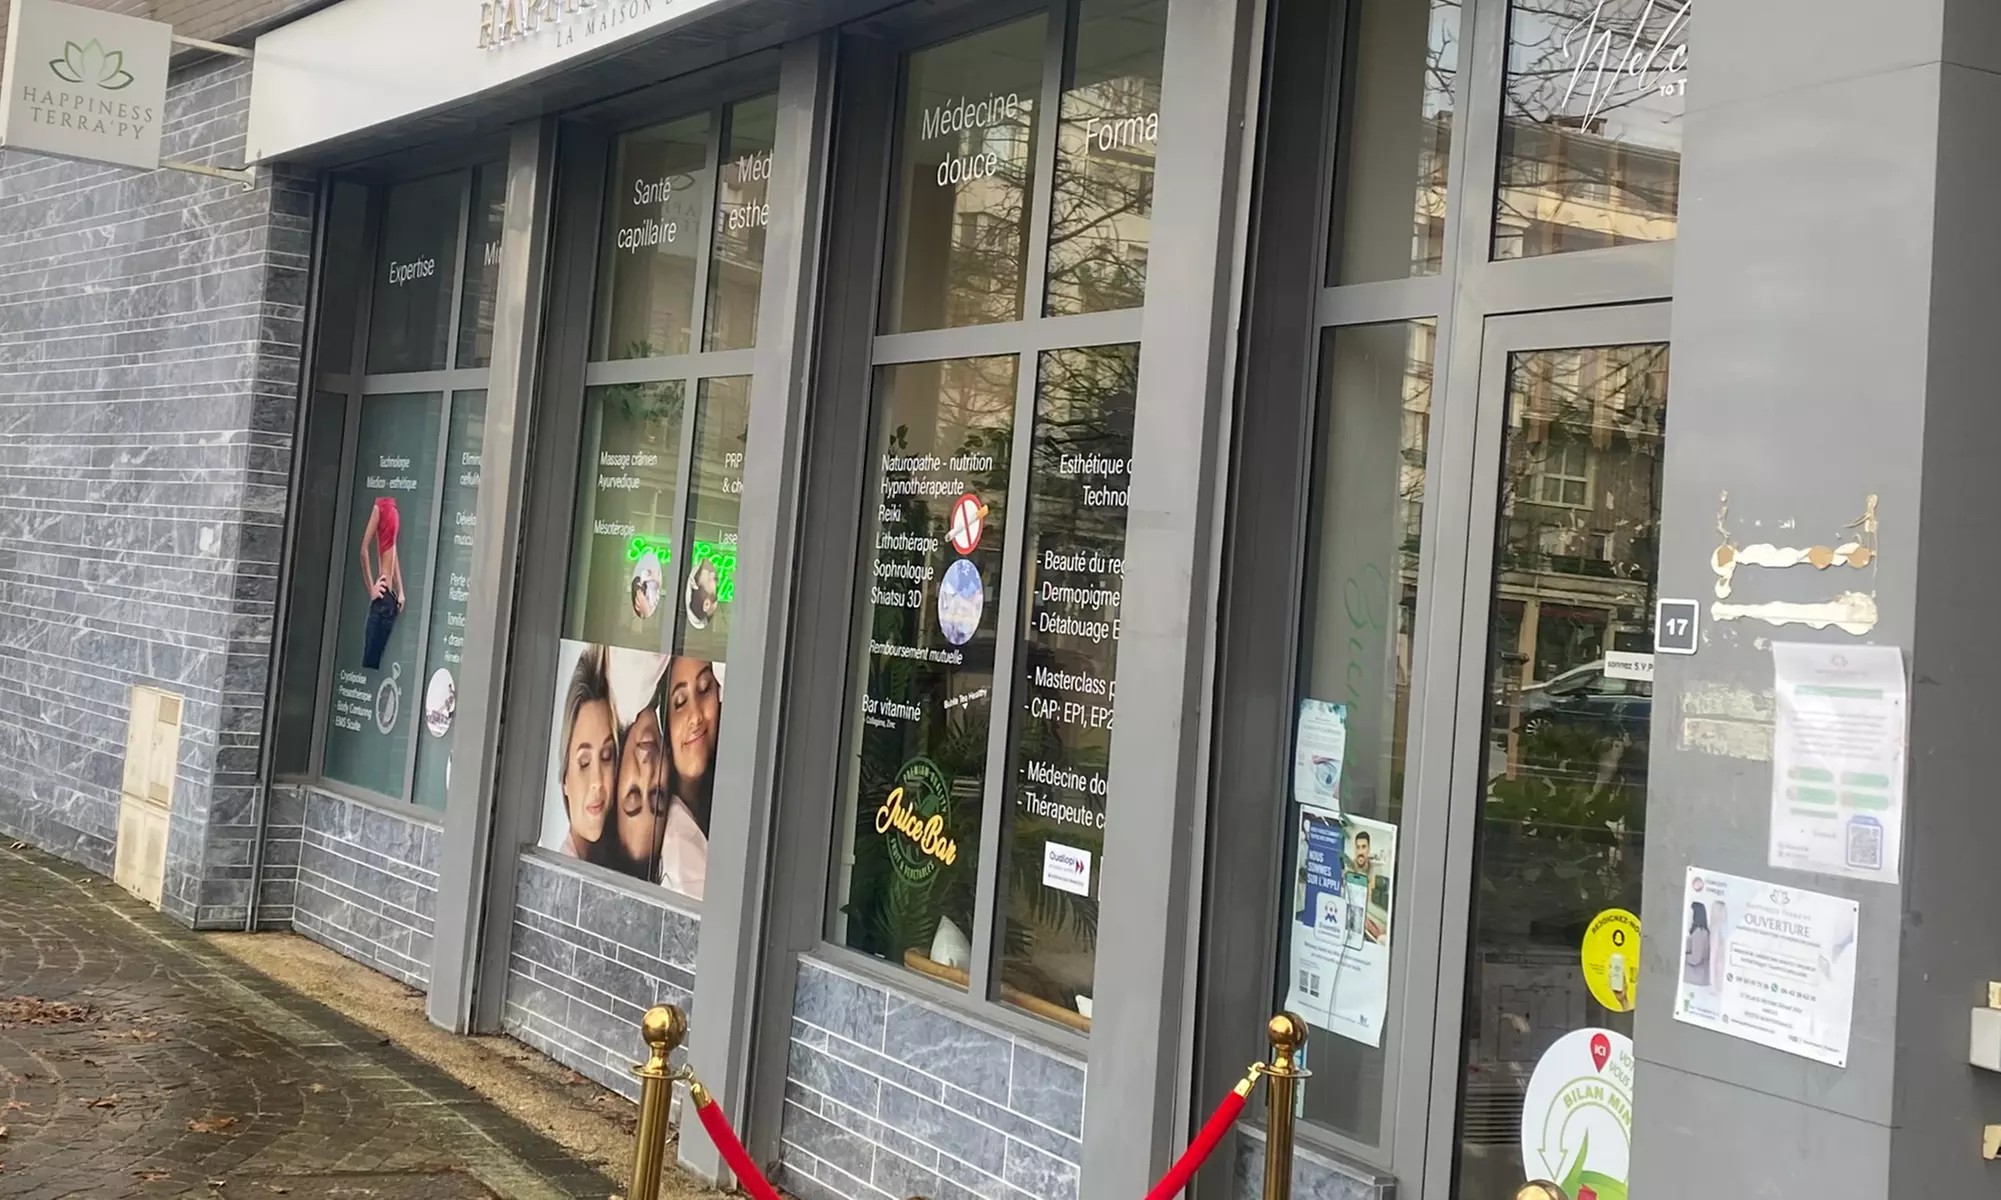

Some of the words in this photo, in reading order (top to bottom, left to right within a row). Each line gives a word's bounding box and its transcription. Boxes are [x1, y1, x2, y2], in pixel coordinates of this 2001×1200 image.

[23, 86, 153, 123] HAPPINESS
[921, 92, 1019, 140] Médecine
[31, 106, 145, 139] TERRA'PY
[1084, 112, 1159, 155] Forma
[937, 152, 998, 187] douce
[633, 176, 672, 205] Santé
[617, 217, 677, 255] capillaire
[389, 253, 435, 287] Expertise
[600, 451, 630, 471] Massage
[724, 452, 743, 470] PRP
[880, 452, 941, 476] Naturopathe
[949, 450, 994, 472] nutrition
[1060, 453, 1124, 479] Esthétique
[879, 475, 965, 499] Hypnothérapeute
[878, 503, 902, 522] Reiki
[874, 530, 939, 556] Lithothérapie
[872, 558, 935, 583] Sophrologue
[1044, 550, 1087, 574] Beauté
[1089, 552, 1106, 574] du
[870, 586, 906, 609] Shiatsu
[906, 589, 923, 609] 3D
[1041, 581, 1121, 611] Dermopigme
[1039, 612, 1110, 644] Détatouage
[1665, 617, 1689, 636] 17
[868, 638, 929, 662] Remboursement
[928, 649, 965, 666] mutuelle
[1035, 665, 1106, 696] Masterclass
[861, 693, 879, 714] Bar
[879, 696, 921, 722] vitaminé
[1031, 696, 1061, 721] CAP:
[1063, 701, 1088, 729] EP1,
[1027, 759, 1087, 792] Médecine
[1025, 790, 1093, 827] Thérapeute
[876, 786, 924, 842] Juice
[921, 814, 958, 866] Bar
[1743, 911, 1812, 939] OUVERTURE
[1563, 1084, 1605, 1109] BILAN
